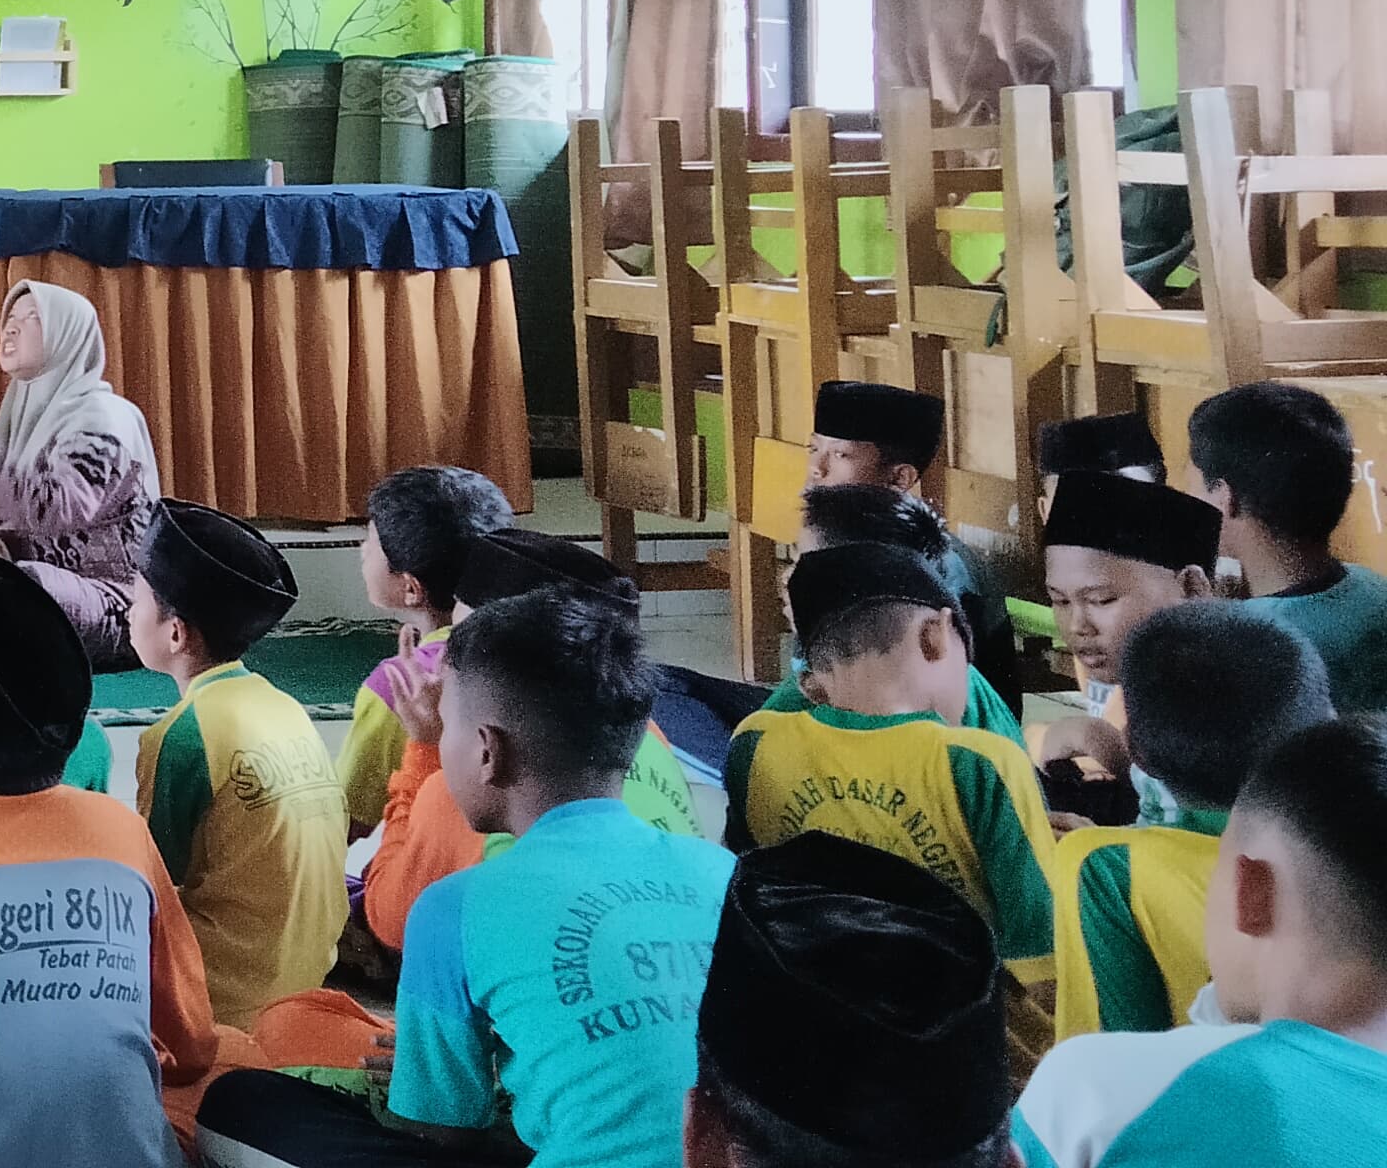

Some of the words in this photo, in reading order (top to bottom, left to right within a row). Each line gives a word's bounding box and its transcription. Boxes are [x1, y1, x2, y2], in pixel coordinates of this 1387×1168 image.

[828, 775, 906, 817] DASAR
[39, 948, 91, 970] Tebat
[552, 891, 614, 1006] SEKOLAH
[602, 879, 699, 908] DASAR
[0, 978, 82, 1005] Muaro
[89, 975, 142, 1004] Jambi
